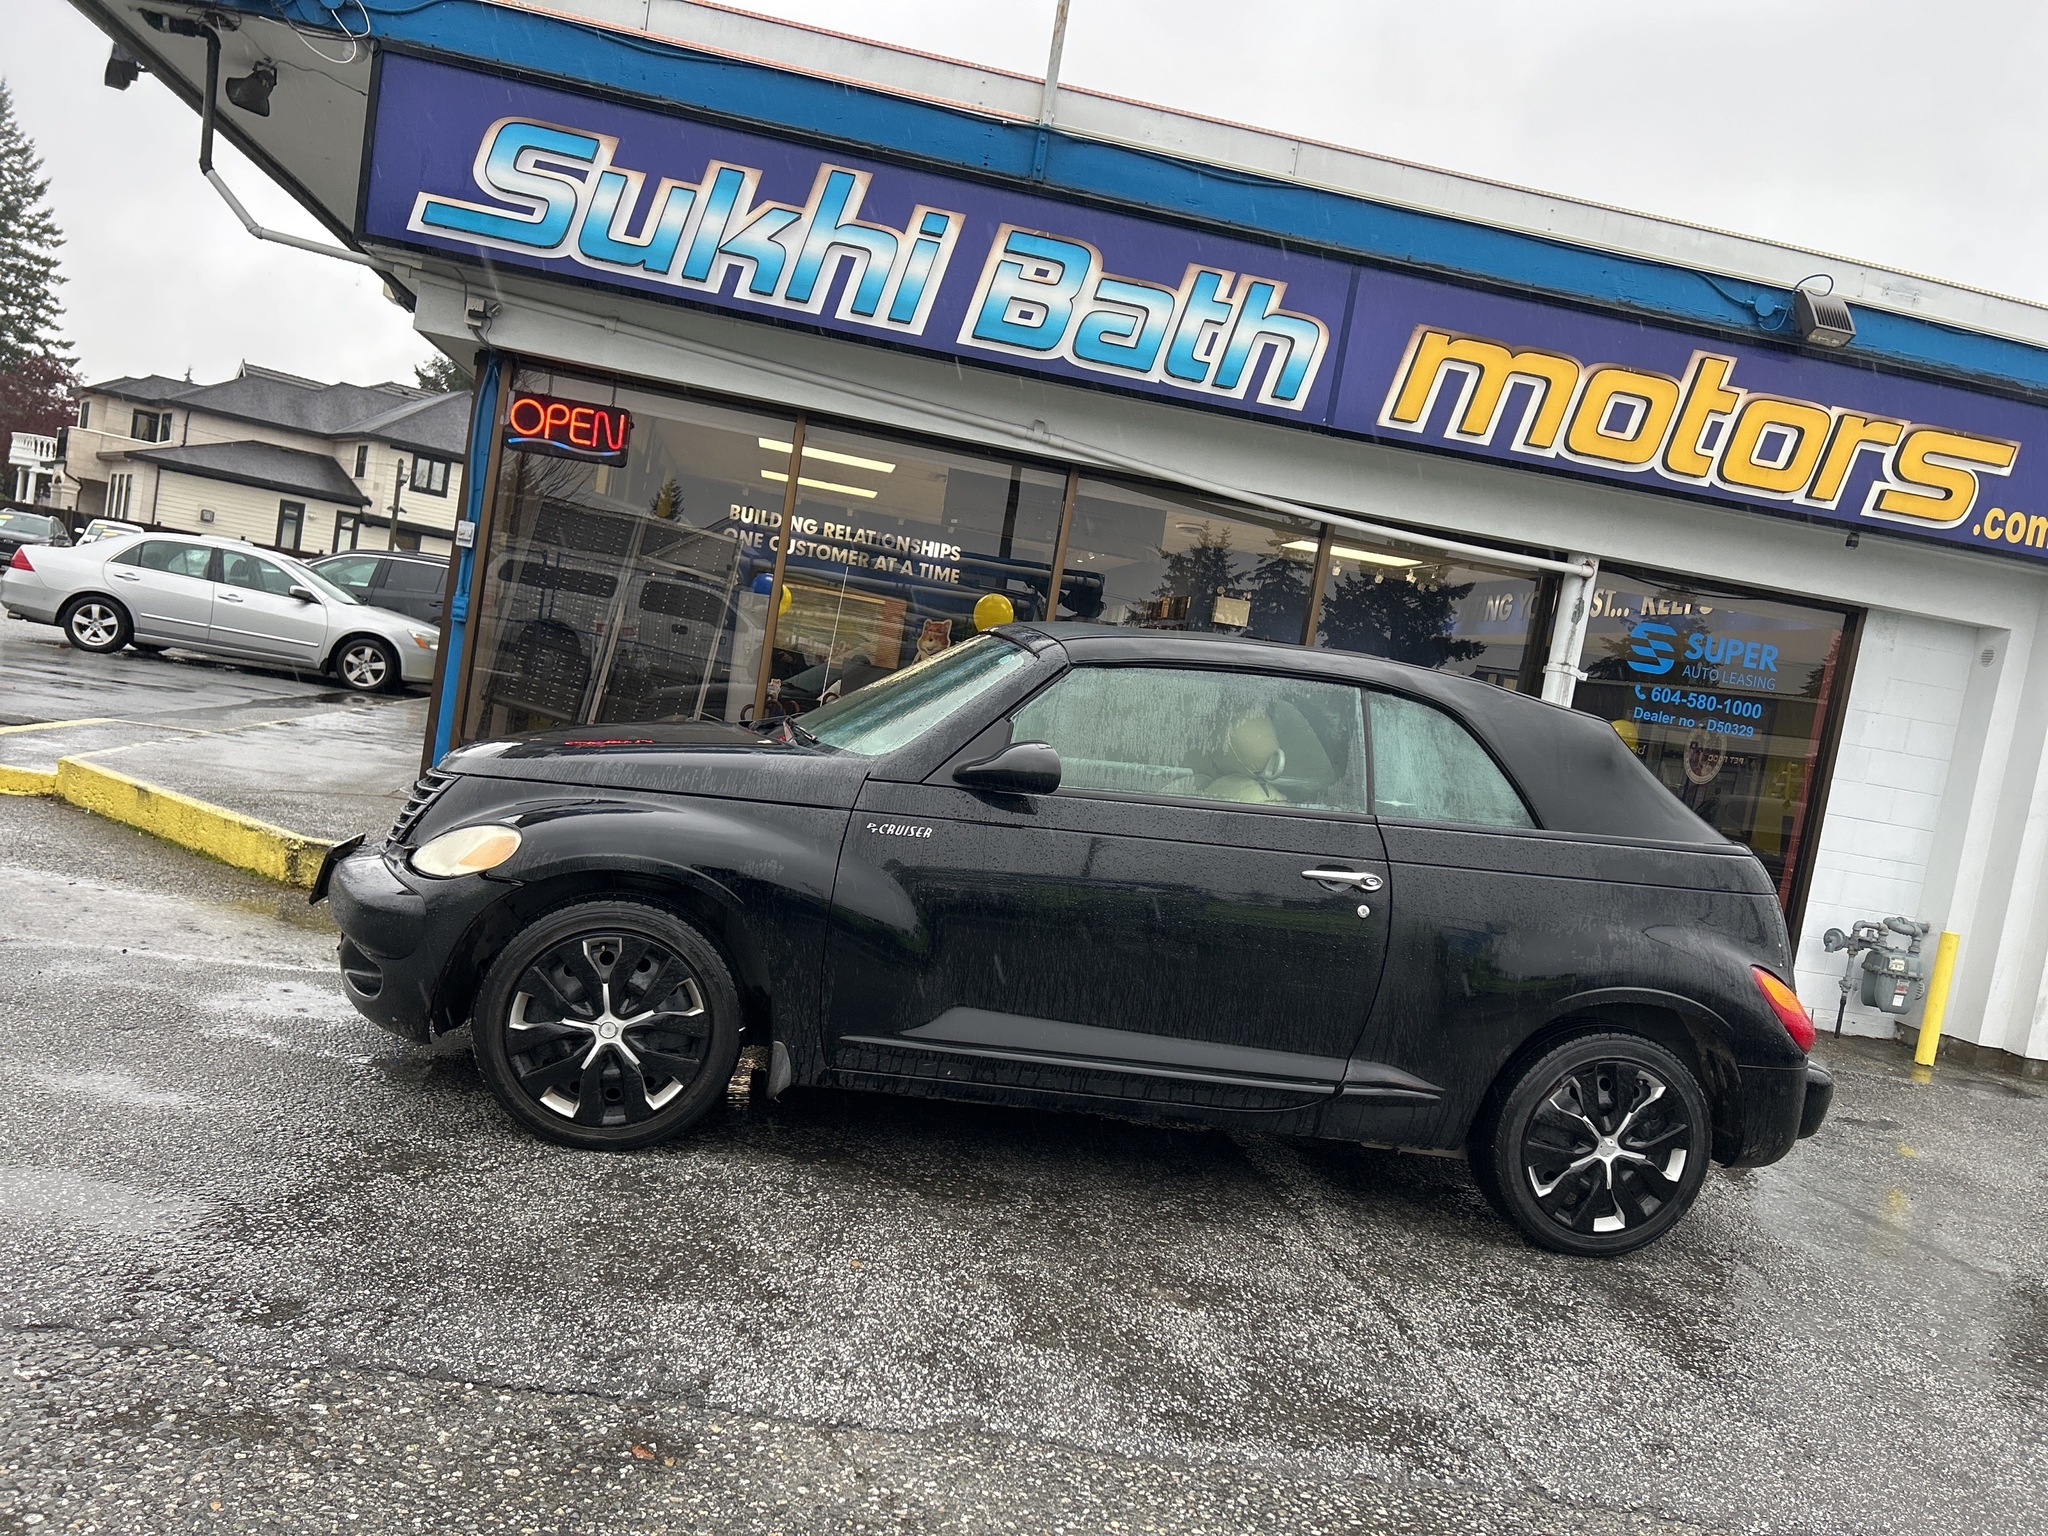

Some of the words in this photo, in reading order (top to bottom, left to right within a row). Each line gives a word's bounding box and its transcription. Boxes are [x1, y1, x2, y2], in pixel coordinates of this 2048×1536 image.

[407, 117, 966, 335] Sukhi
[956, 223, 1329, 410] Bath
[1376, 324, 2020, 529] motors
[510, 398, 625, 450] OPEN
[730, 504, 818, 534] BUILDNG
[823, 522, 961, 561] RELATIONSHIPS
[723, 528, 763, 548] ONE
[874, 556, 898, 572] AT
[900, 561, 913, 576] A
[919, 563, 960, 584] TIME
[1684, 632, 1778, 672] SUPER
[1682, 665, 1719, 681] AUTO
[1722, 672, 1776, 691] LEASING
[1633, 706, 1675, 725] Dealer
[1678, 716, 1695, 728] no
[1707, 719, 1754, 738] D50329
[1651, 686, 1762, 719] 604-580-1000
[878, 823, 932, 838] CRUISER
